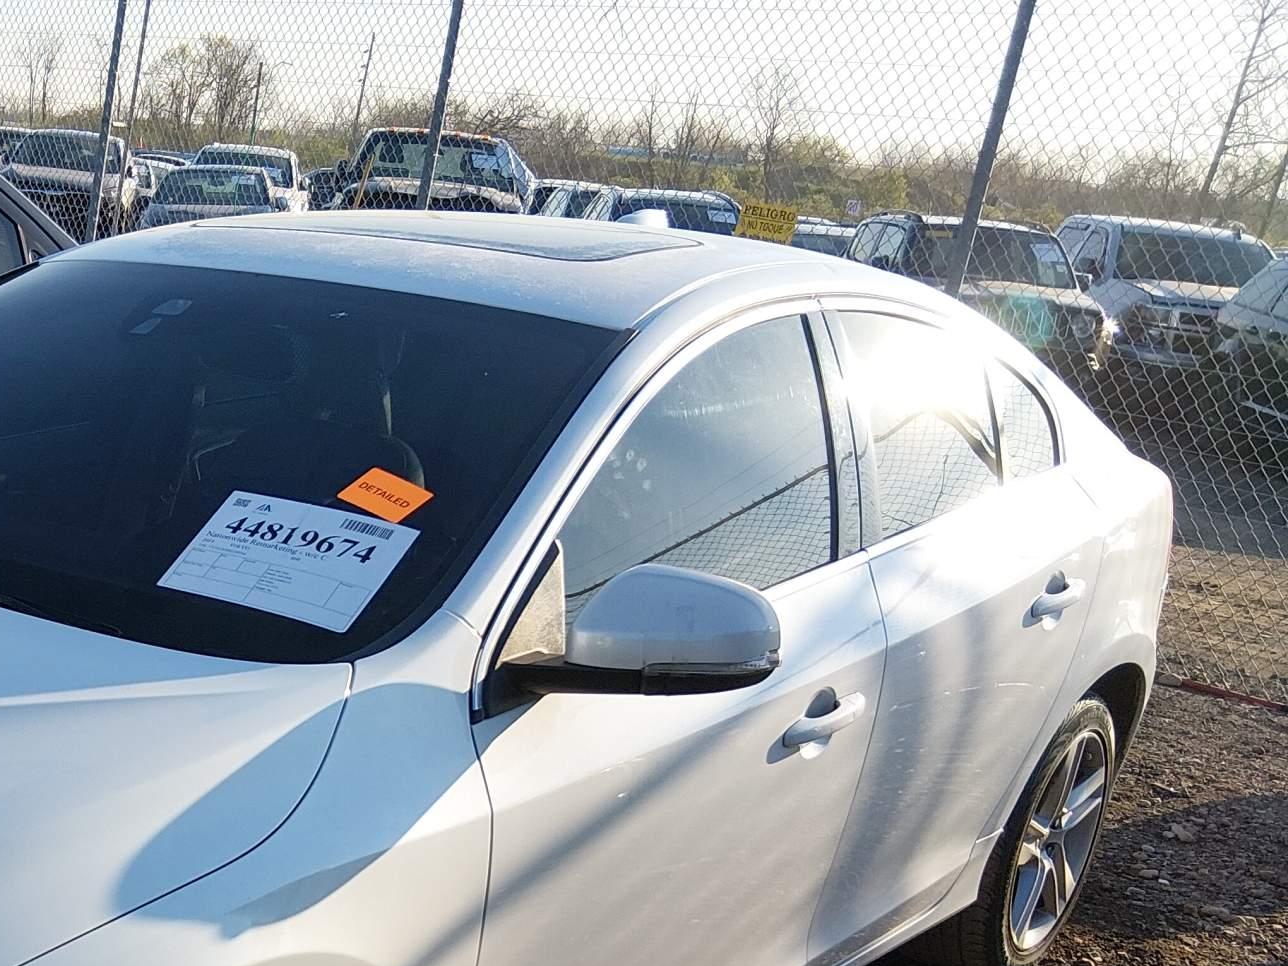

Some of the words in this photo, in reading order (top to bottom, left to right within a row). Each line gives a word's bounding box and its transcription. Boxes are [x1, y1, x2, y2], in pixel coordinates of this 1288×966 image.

[743, 205, 796, 222] PELIGRO
[358, 481, 410, 509] DETAILED
[206, 530, 250, 545] Nationwide
[250, 538, 298, 556] Remarketing
[225, 516, 377, 564] 44819674
